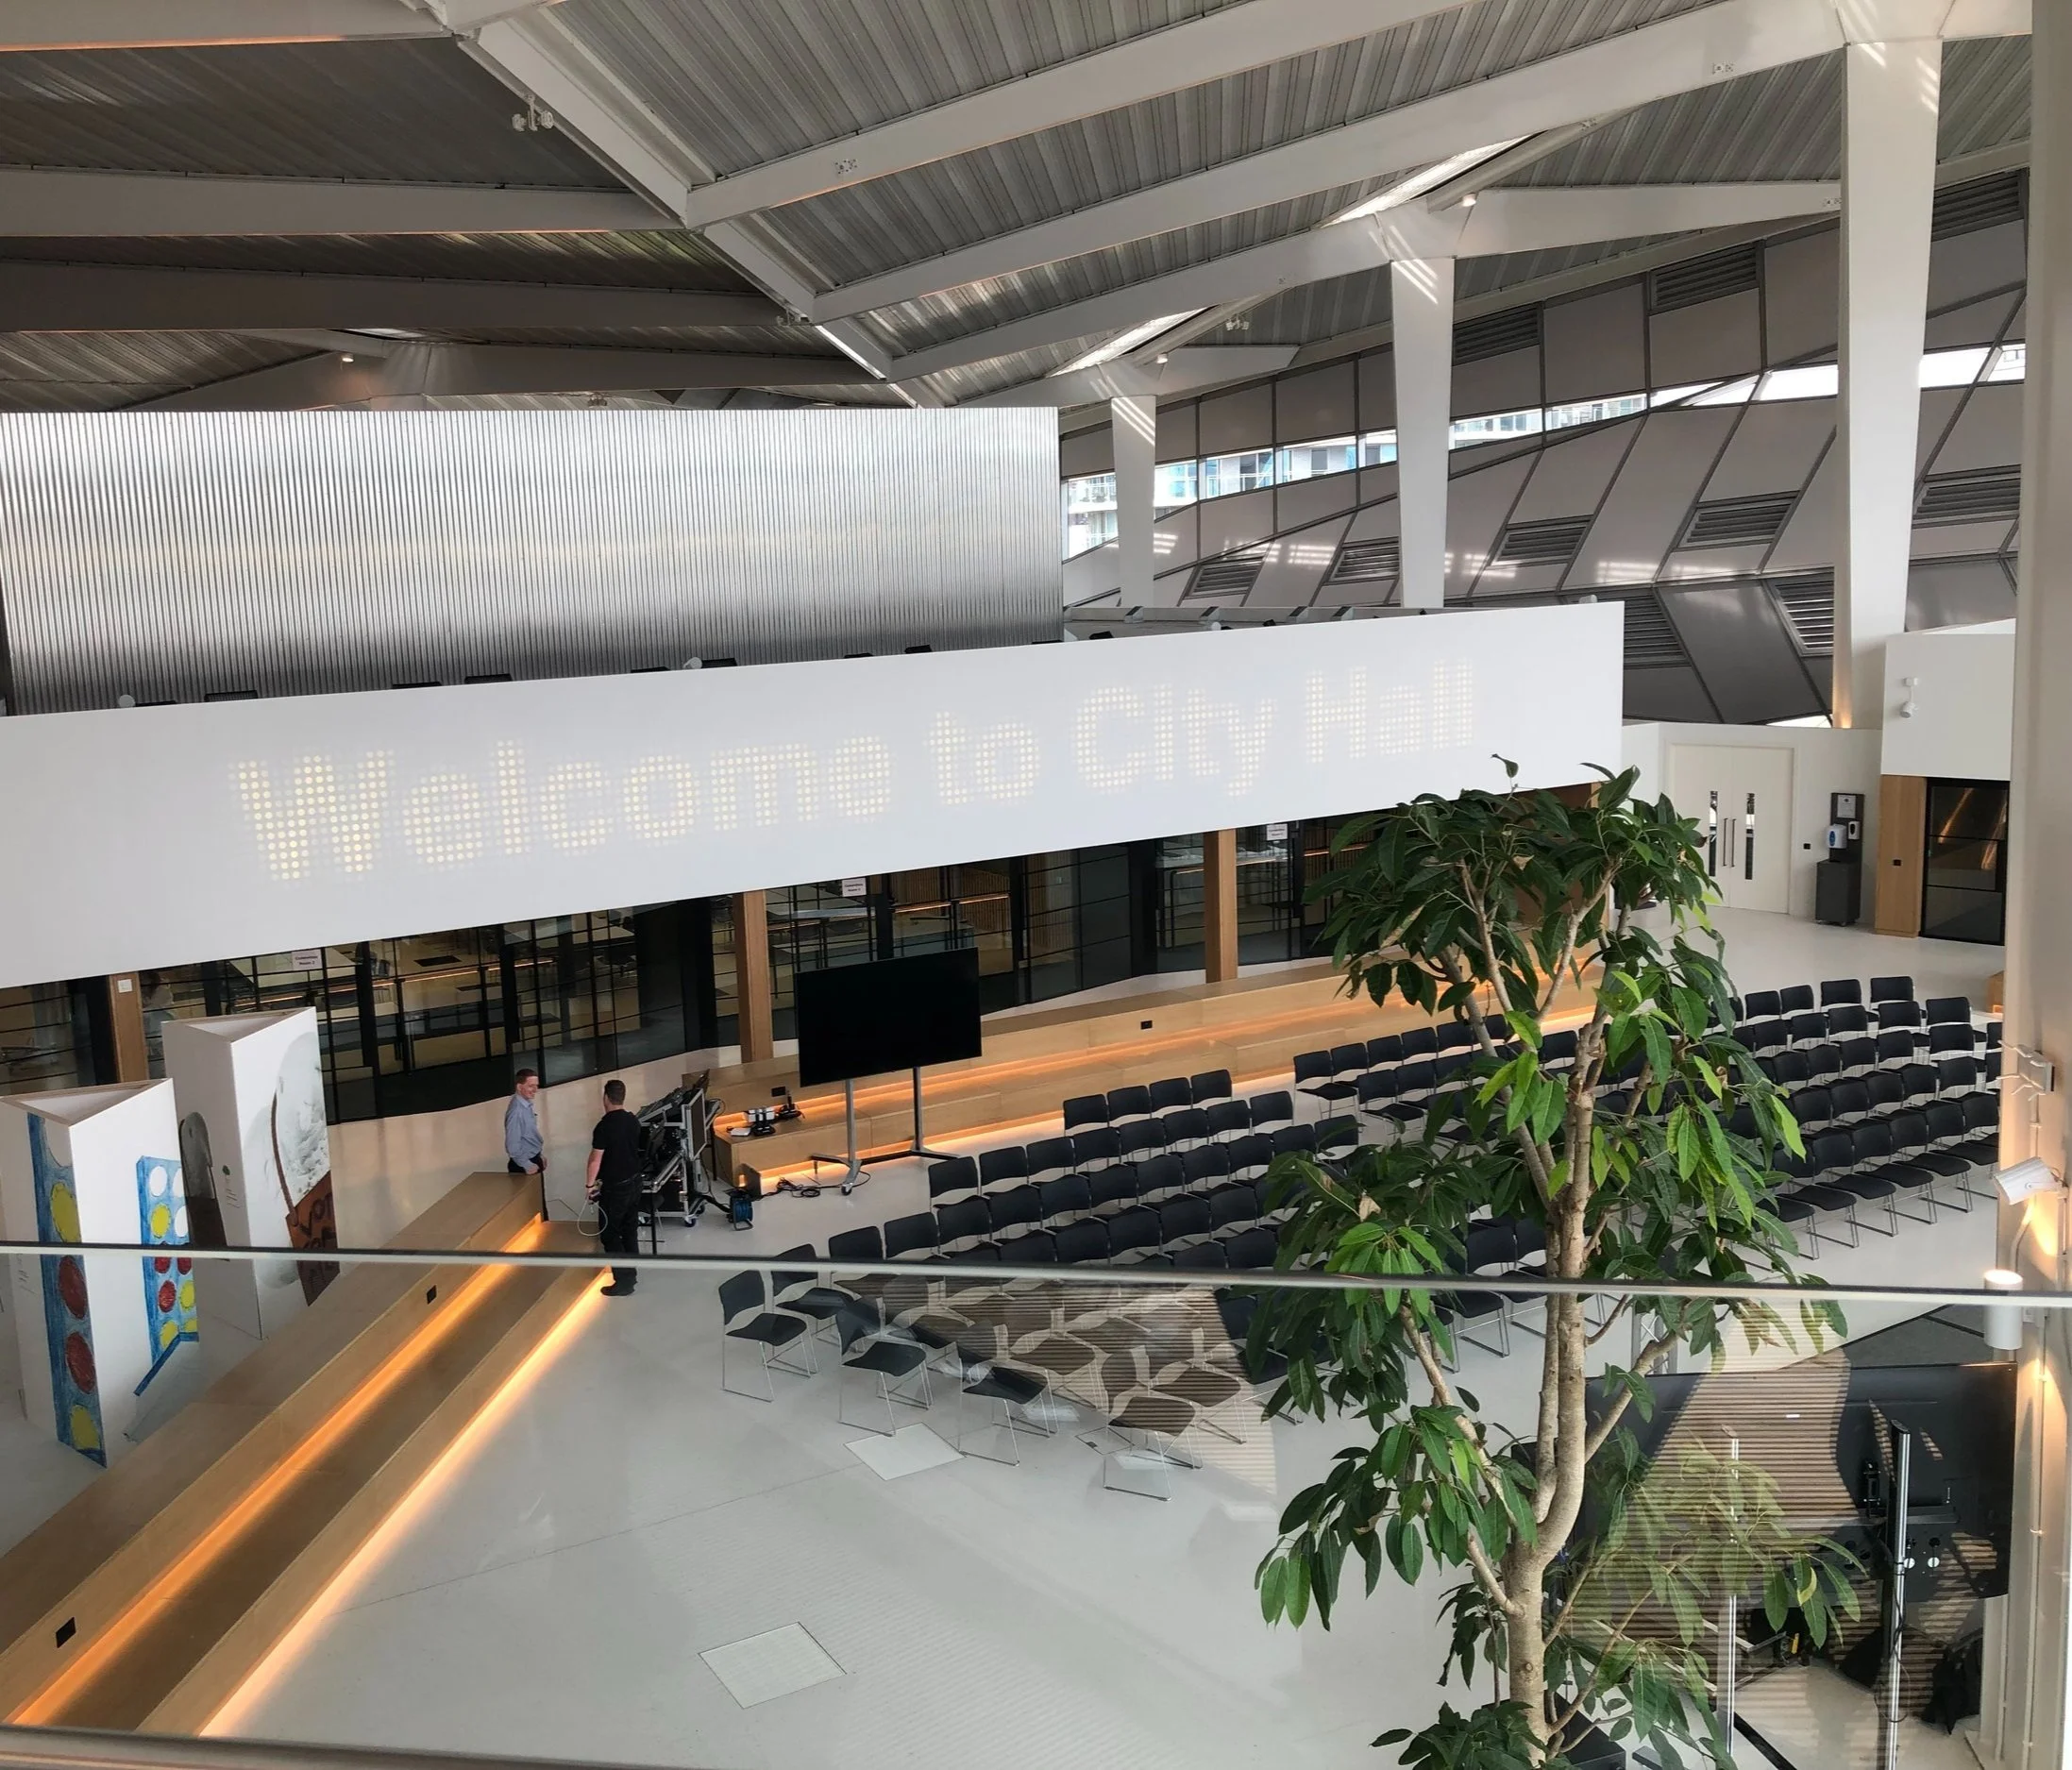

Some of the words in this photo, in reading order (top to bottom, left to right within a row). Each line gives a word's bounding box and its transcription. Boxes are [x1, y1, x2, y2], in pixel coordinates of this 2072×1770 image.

[235, 733, 892, 881] Welcome
[929, 710, 1036, 806] to
[1074, 682, 1277, 797] City
[1305, 657, 1474, 765] Hall
